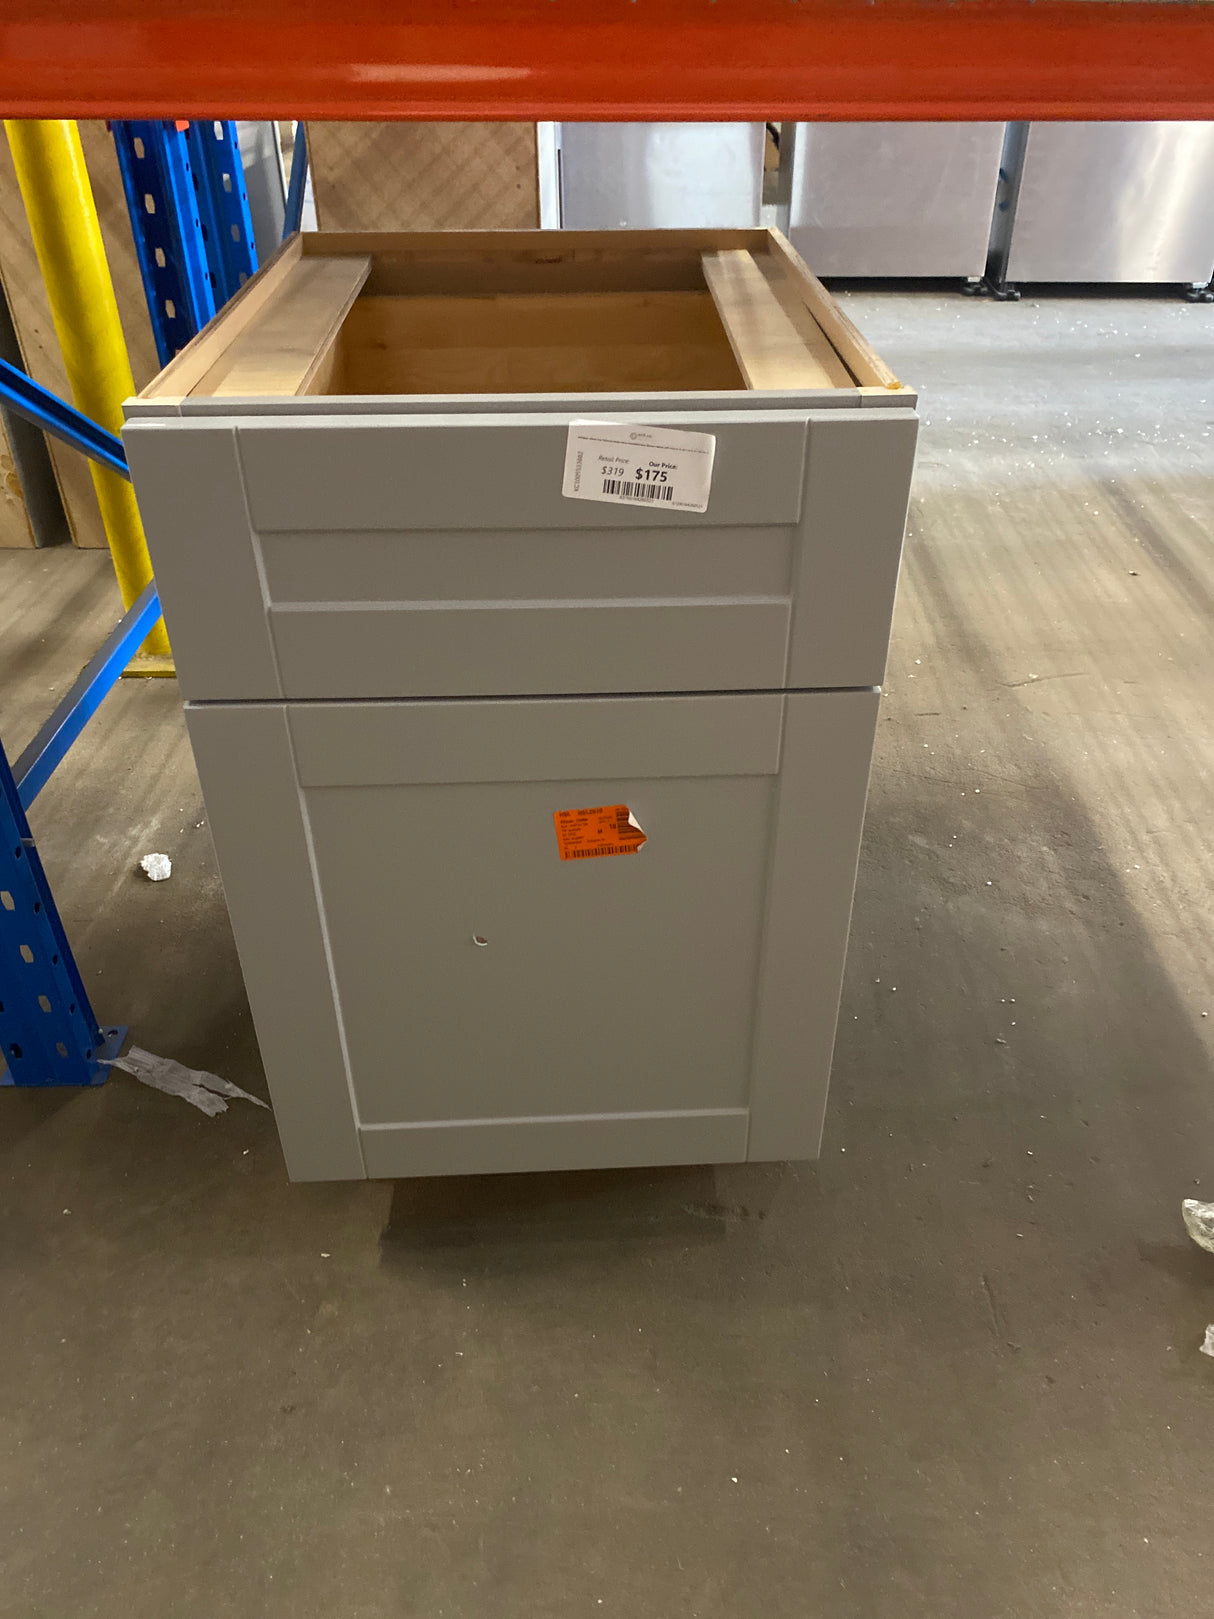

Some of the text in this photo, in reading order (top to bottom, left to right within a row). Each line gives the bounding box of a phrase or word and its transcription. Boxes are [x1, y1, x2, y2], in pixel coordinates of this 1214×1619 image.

[601, 466, 625, 477] $319
[661, 462, 678, 470] Price:
[635, 467, 668, 482] $175
